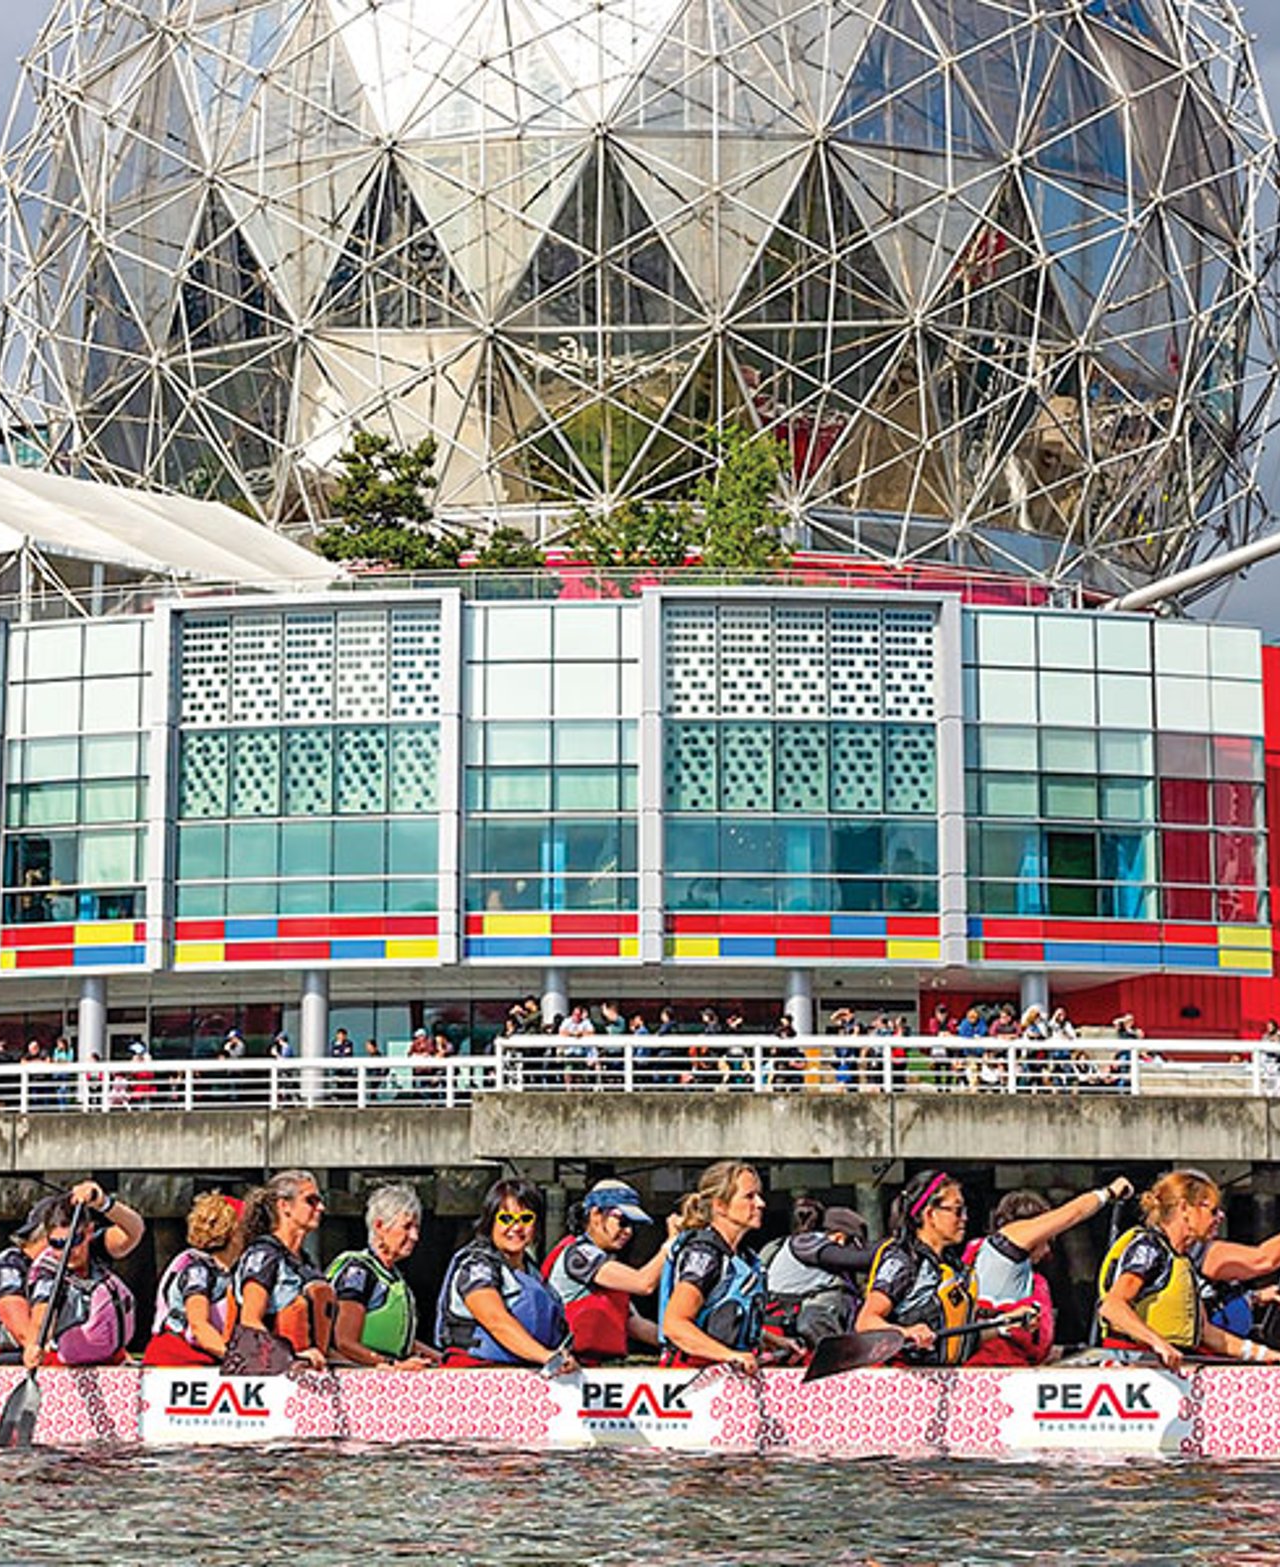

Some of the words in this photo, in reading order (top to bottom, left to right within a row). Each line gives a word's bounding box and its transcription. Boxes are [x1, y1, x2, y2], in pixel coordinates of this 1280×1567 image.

[170, 1381, 266, 1414] PEAK
[581, 1383, 687, 1418] PEAK
[1036, 1383, 1153, 1418] PEAK
